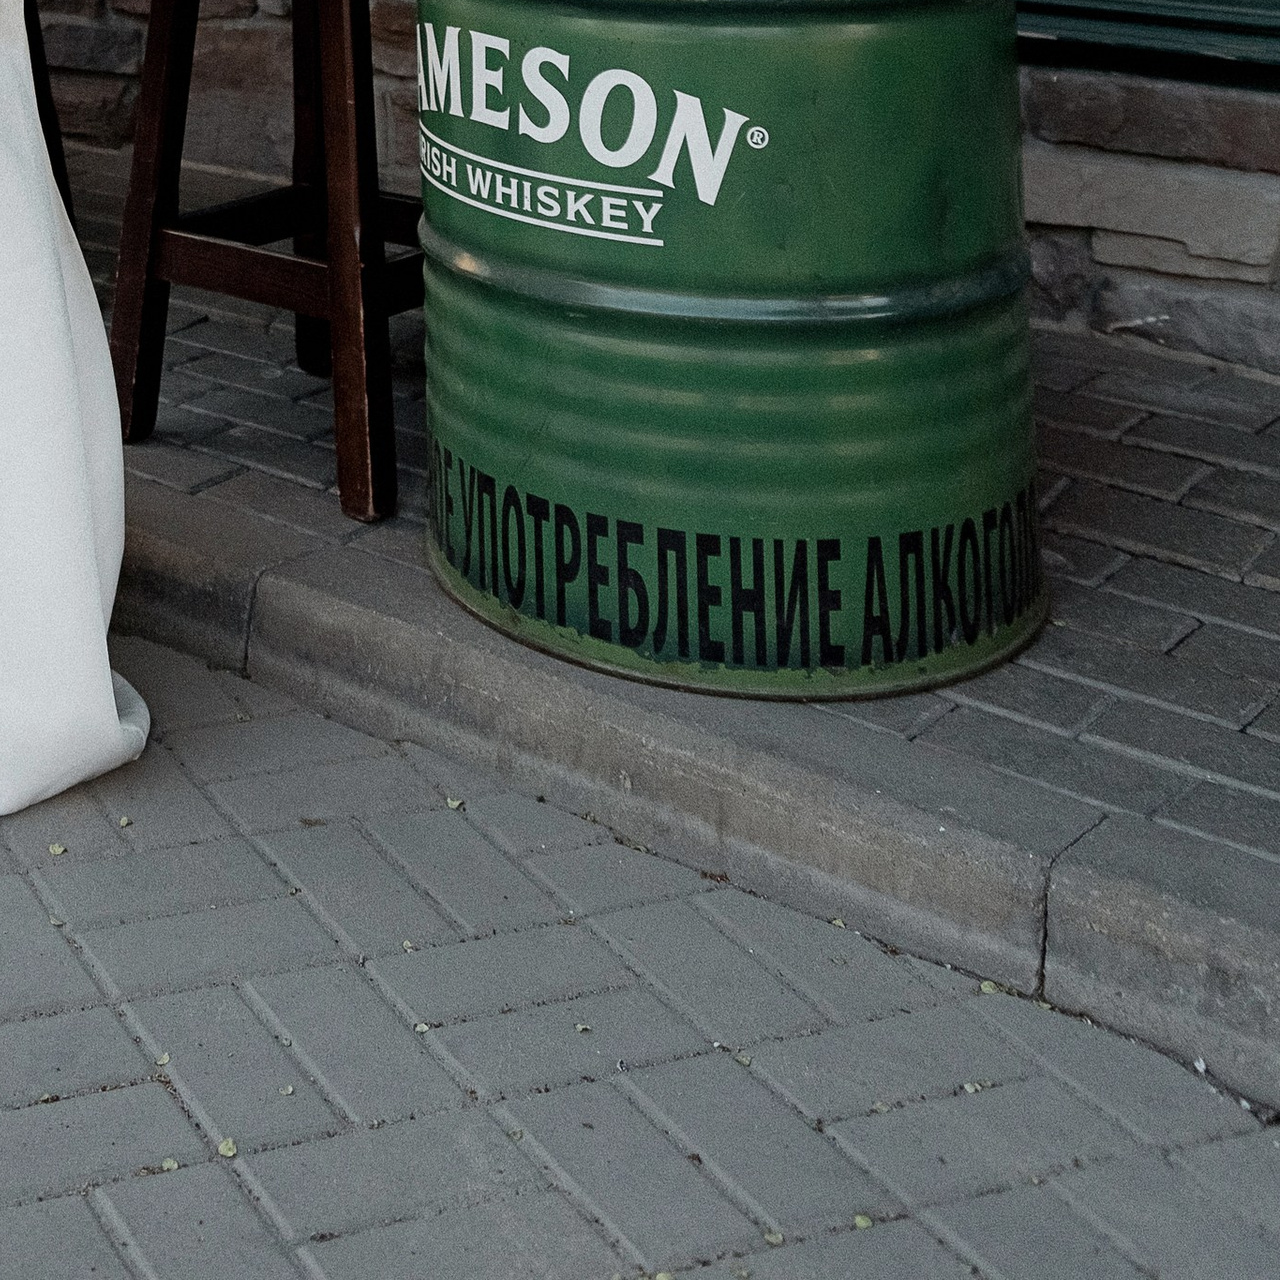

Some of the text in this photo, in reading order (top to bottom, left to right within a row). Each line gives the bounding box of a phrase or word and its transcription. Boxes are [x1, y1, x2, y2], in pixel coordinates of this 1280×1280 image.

[418, 134, 664, 234] RISH WHISKEY
[458, 456, 846, 669] УПОТРЕБЛЕНИЕ
